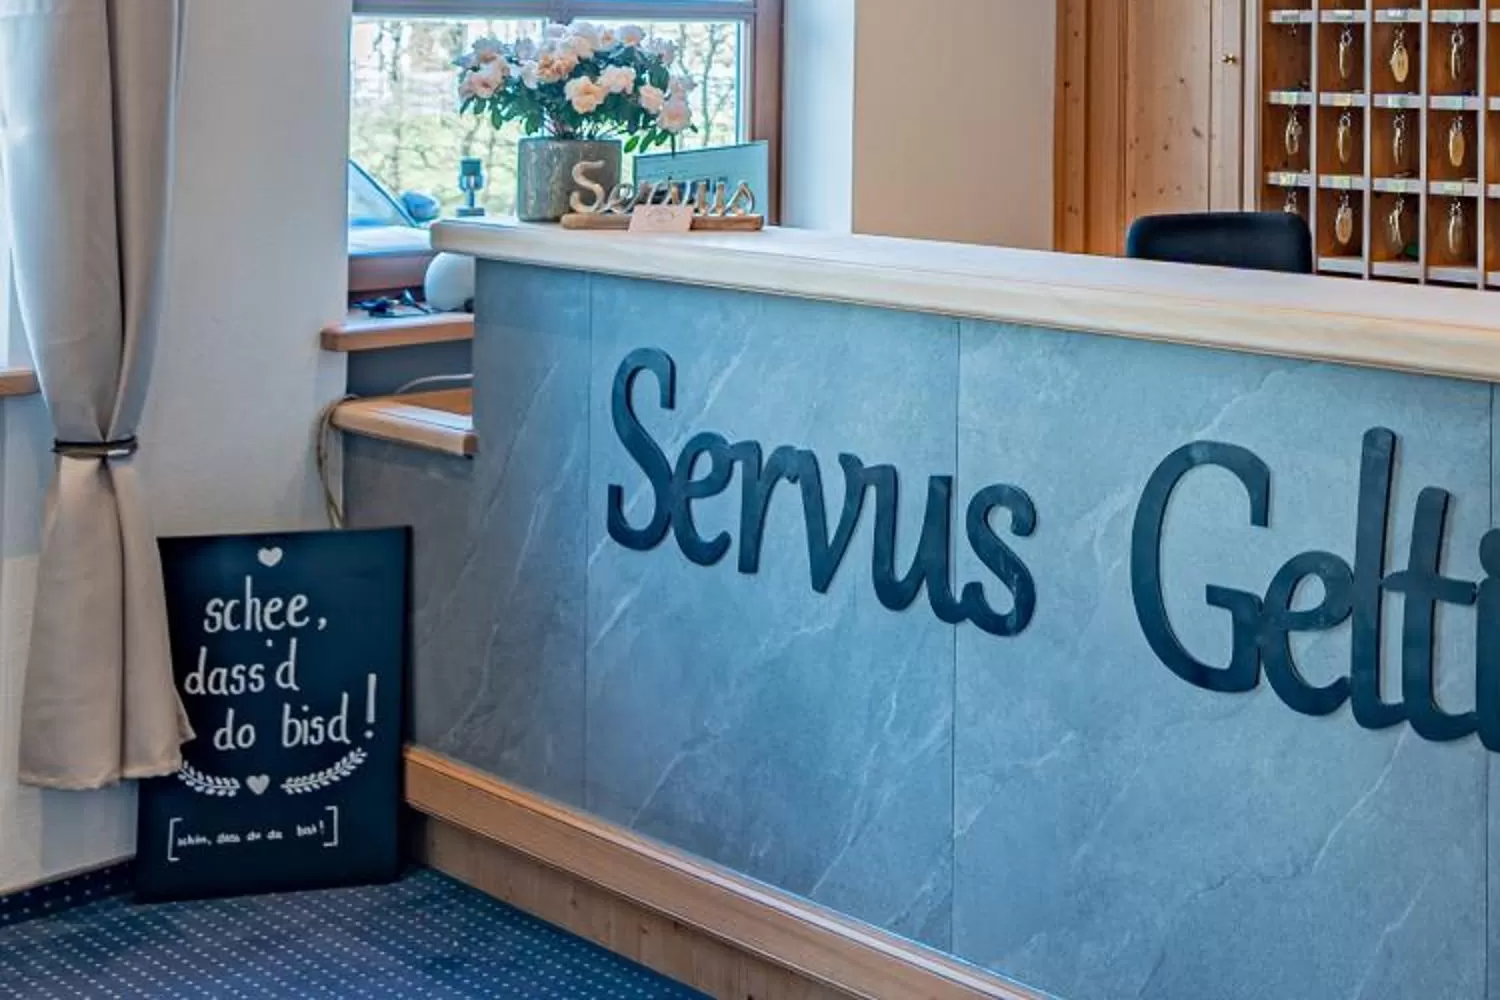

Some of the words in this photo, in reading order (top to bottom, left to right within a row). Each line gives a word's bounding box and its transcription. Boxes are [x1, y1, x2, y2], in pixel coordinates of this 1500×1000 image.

[607, 347, 1037, 637] Servus
[203, 575, 328, 633] schee,
[213, 708, 256, 750] do
